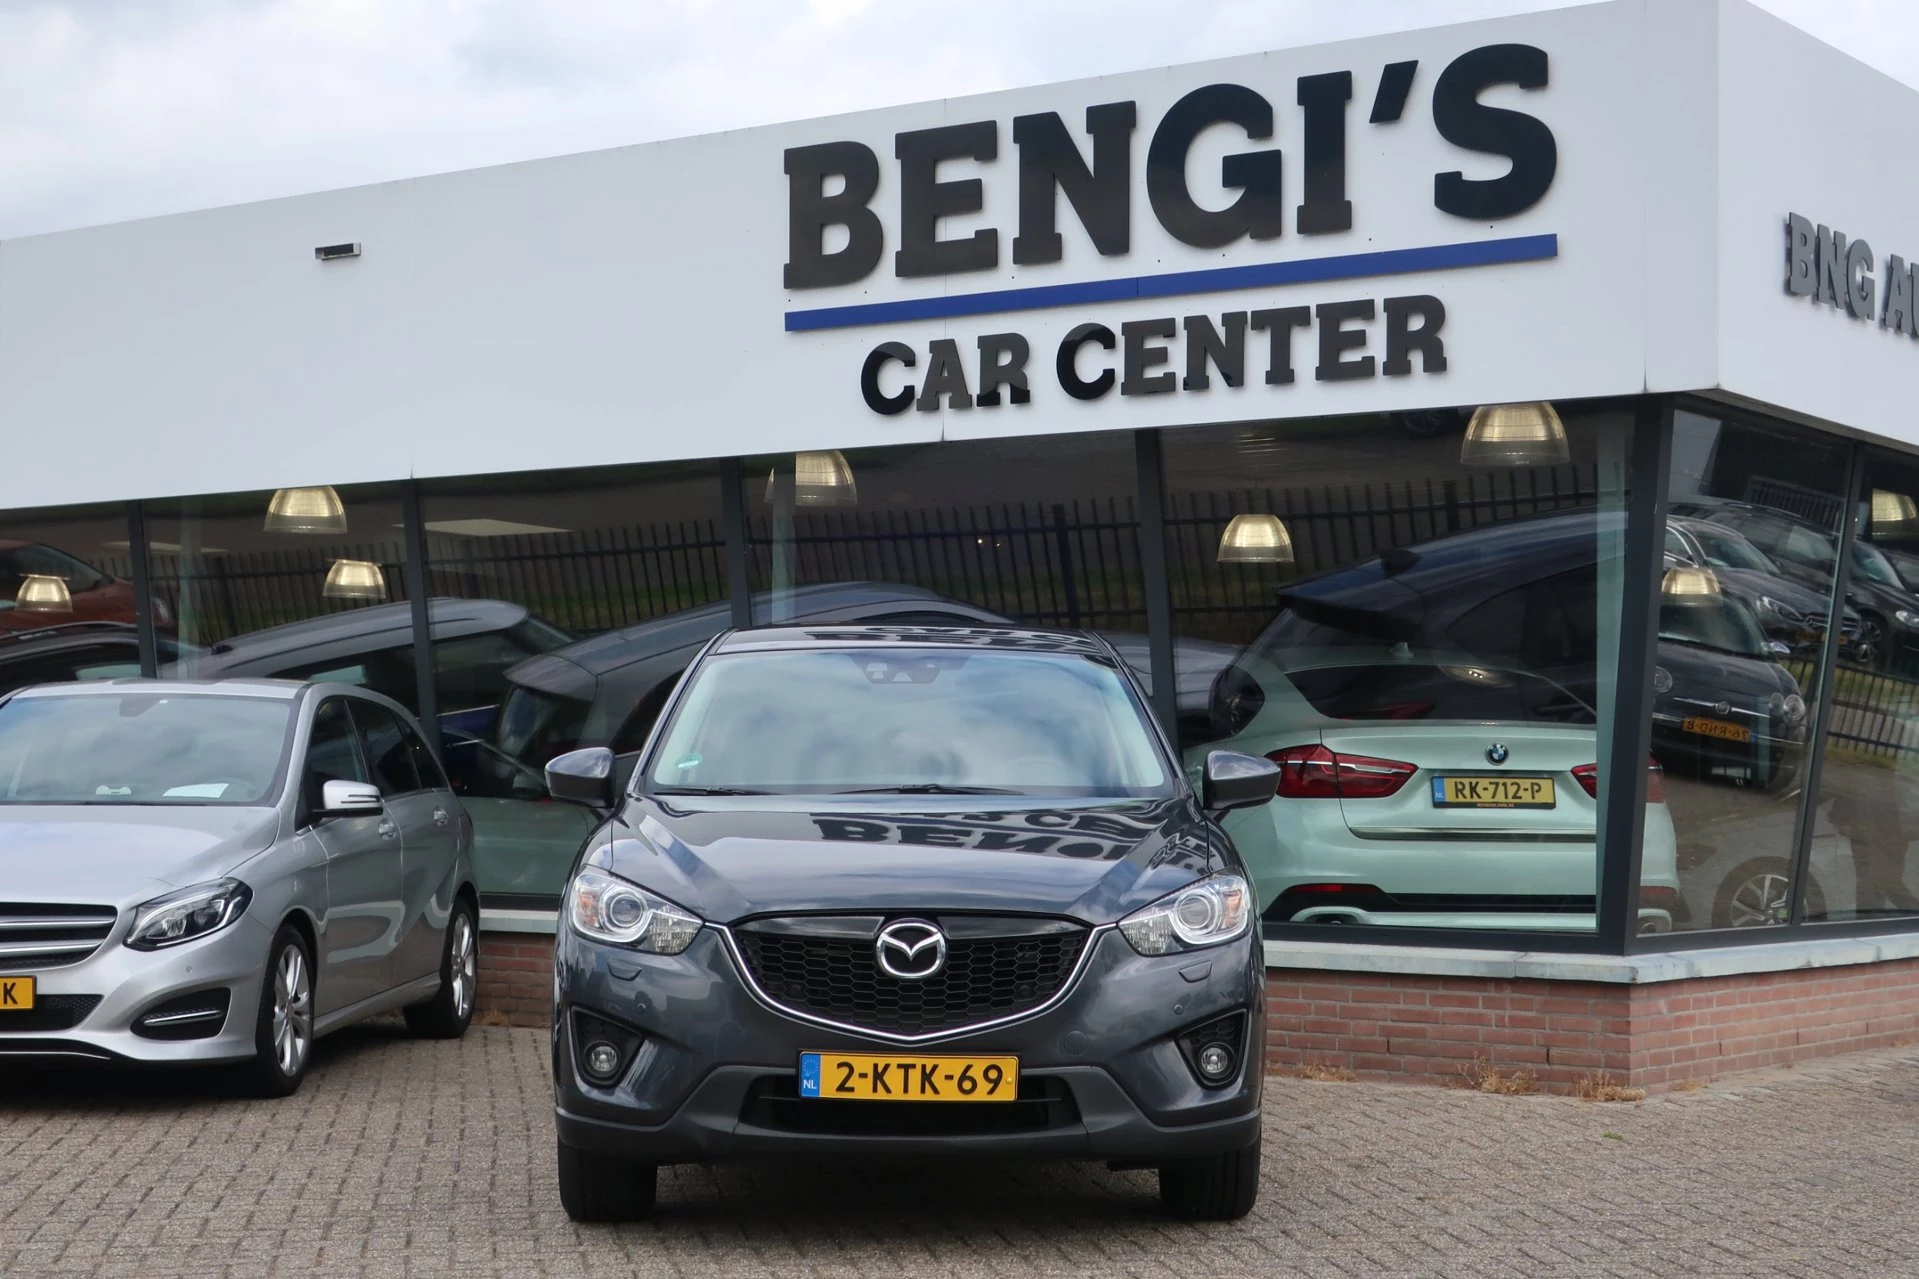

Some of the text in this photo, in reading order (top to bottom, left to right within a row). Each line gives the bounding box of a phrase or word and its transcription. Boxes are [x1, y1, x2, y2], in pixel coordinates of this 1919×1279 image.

[783, 43, 1558, 291] BENGI'S
[1786, 211, 1876, 322] BNG
[860, 294, 1448, 415] CAR CENTER
[1453, 780, 1543, 800] RK-712-P
[803, 1061, 1004, 1096] NL 2-KTK-69
